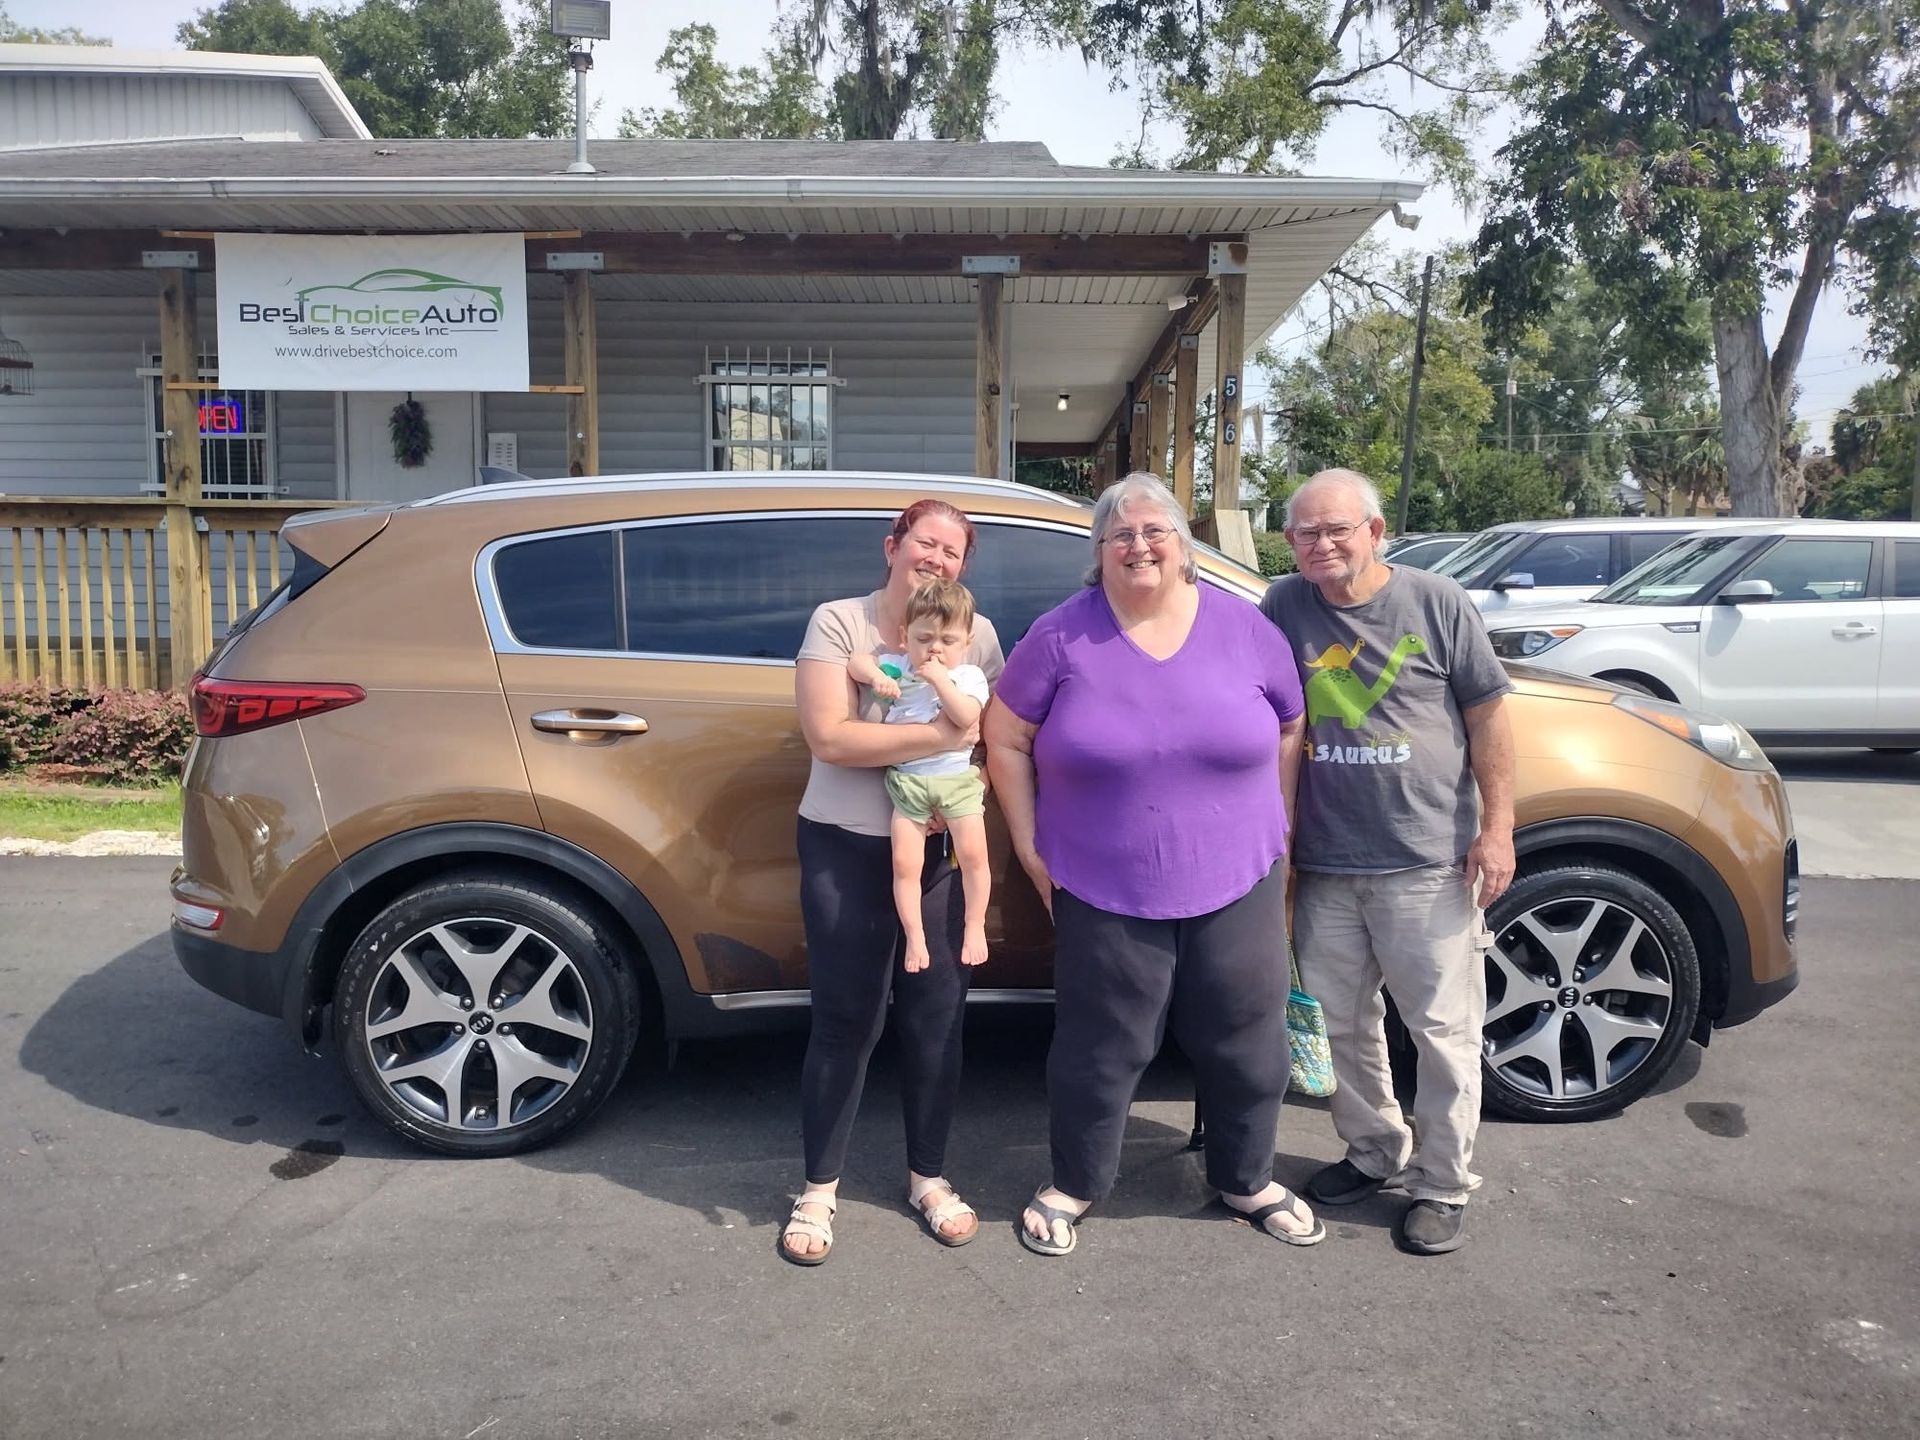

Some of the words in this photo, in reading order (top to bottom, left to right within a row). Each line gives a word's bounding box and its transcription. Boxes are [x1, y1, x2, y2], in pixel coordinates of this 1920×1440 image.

[288, 325, 330, 335] Sales
[334, 325, 345, 335] &
[350, 326, 421, 336] Services
[425, 326, 450, 336] Inc
[275, 343, 458, 359] www.drivebestchoice.com
[1564, 988, 1575, 1007] KIA
[470, 1015, 493, 1033] KIA
